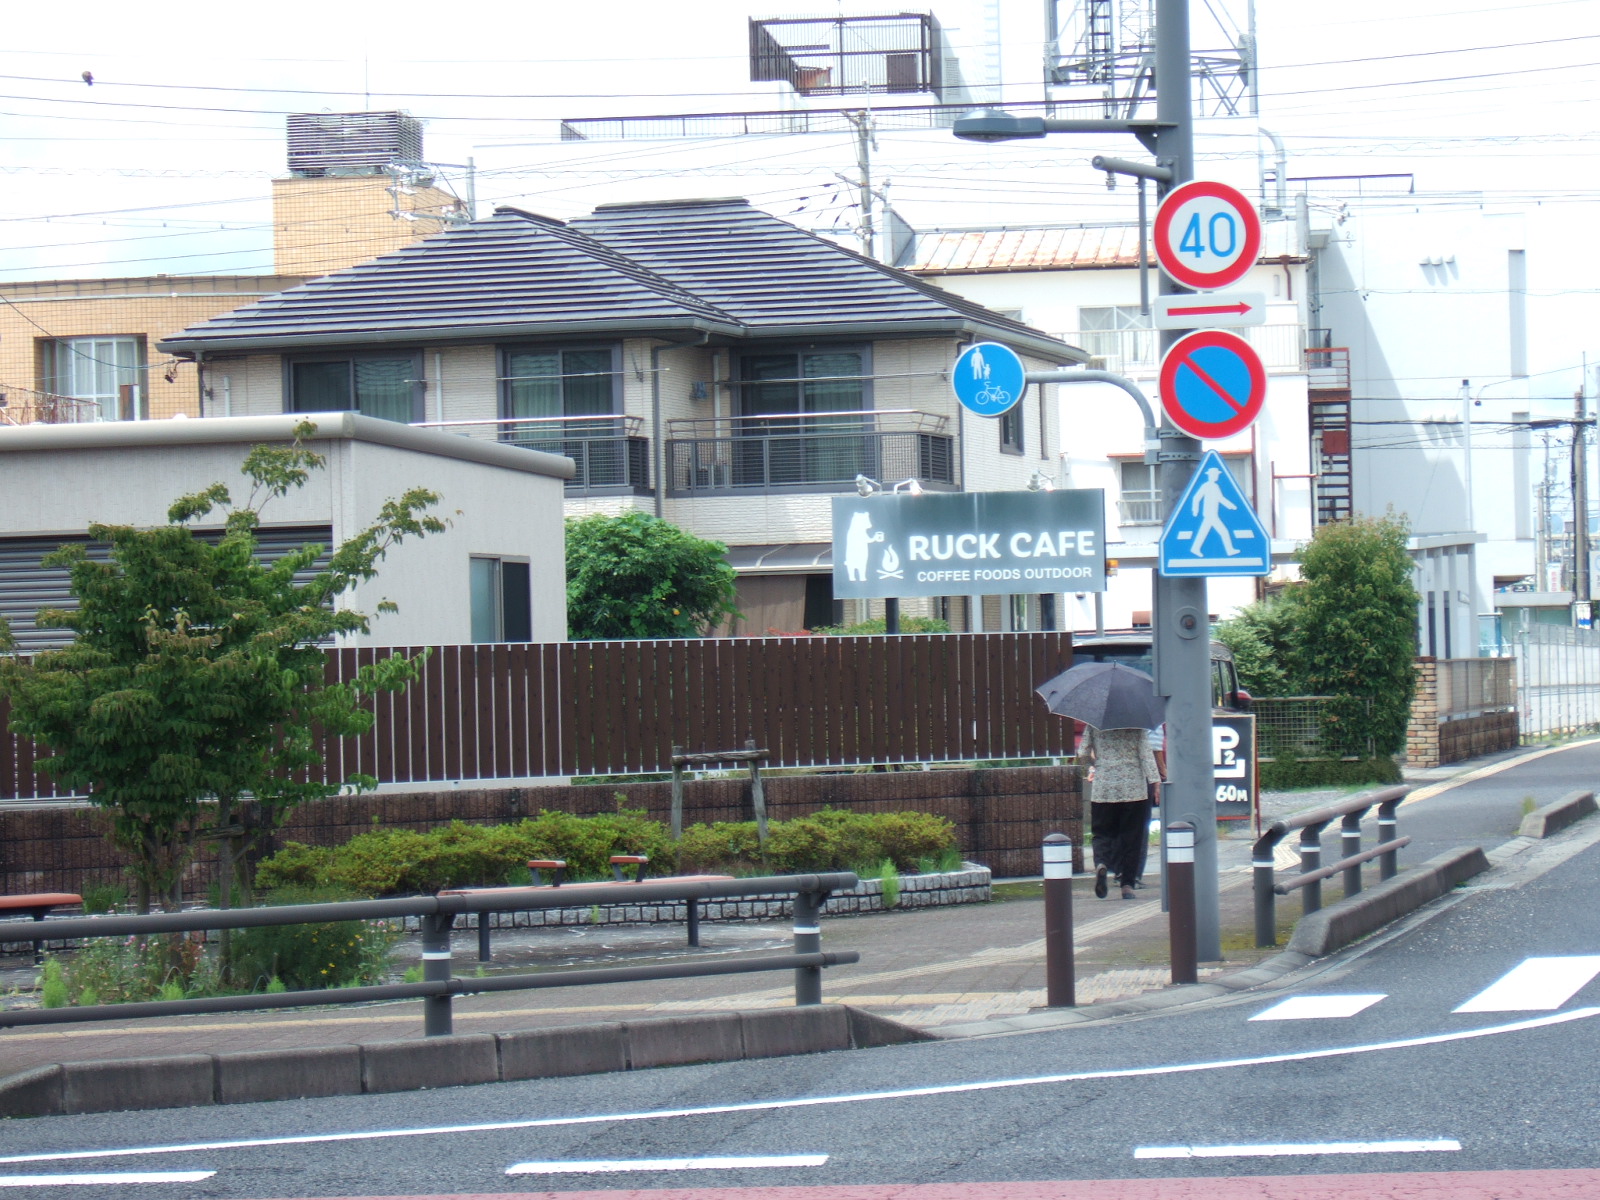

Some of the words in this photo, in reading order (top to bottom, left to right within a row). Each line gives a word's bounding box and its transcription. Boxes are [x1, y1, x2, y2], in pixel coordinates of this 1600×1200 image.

[1179, 212, 1236, 258] 40
[908, 533, 1002, 561] RUCK
[1009, 530, 1096, 558] CAFE
[917, 570, 971, 582] COFFEE
[974, 568, 1021, 581] FOODS
[1024, 567, 1093, 580] OUTDOOR
